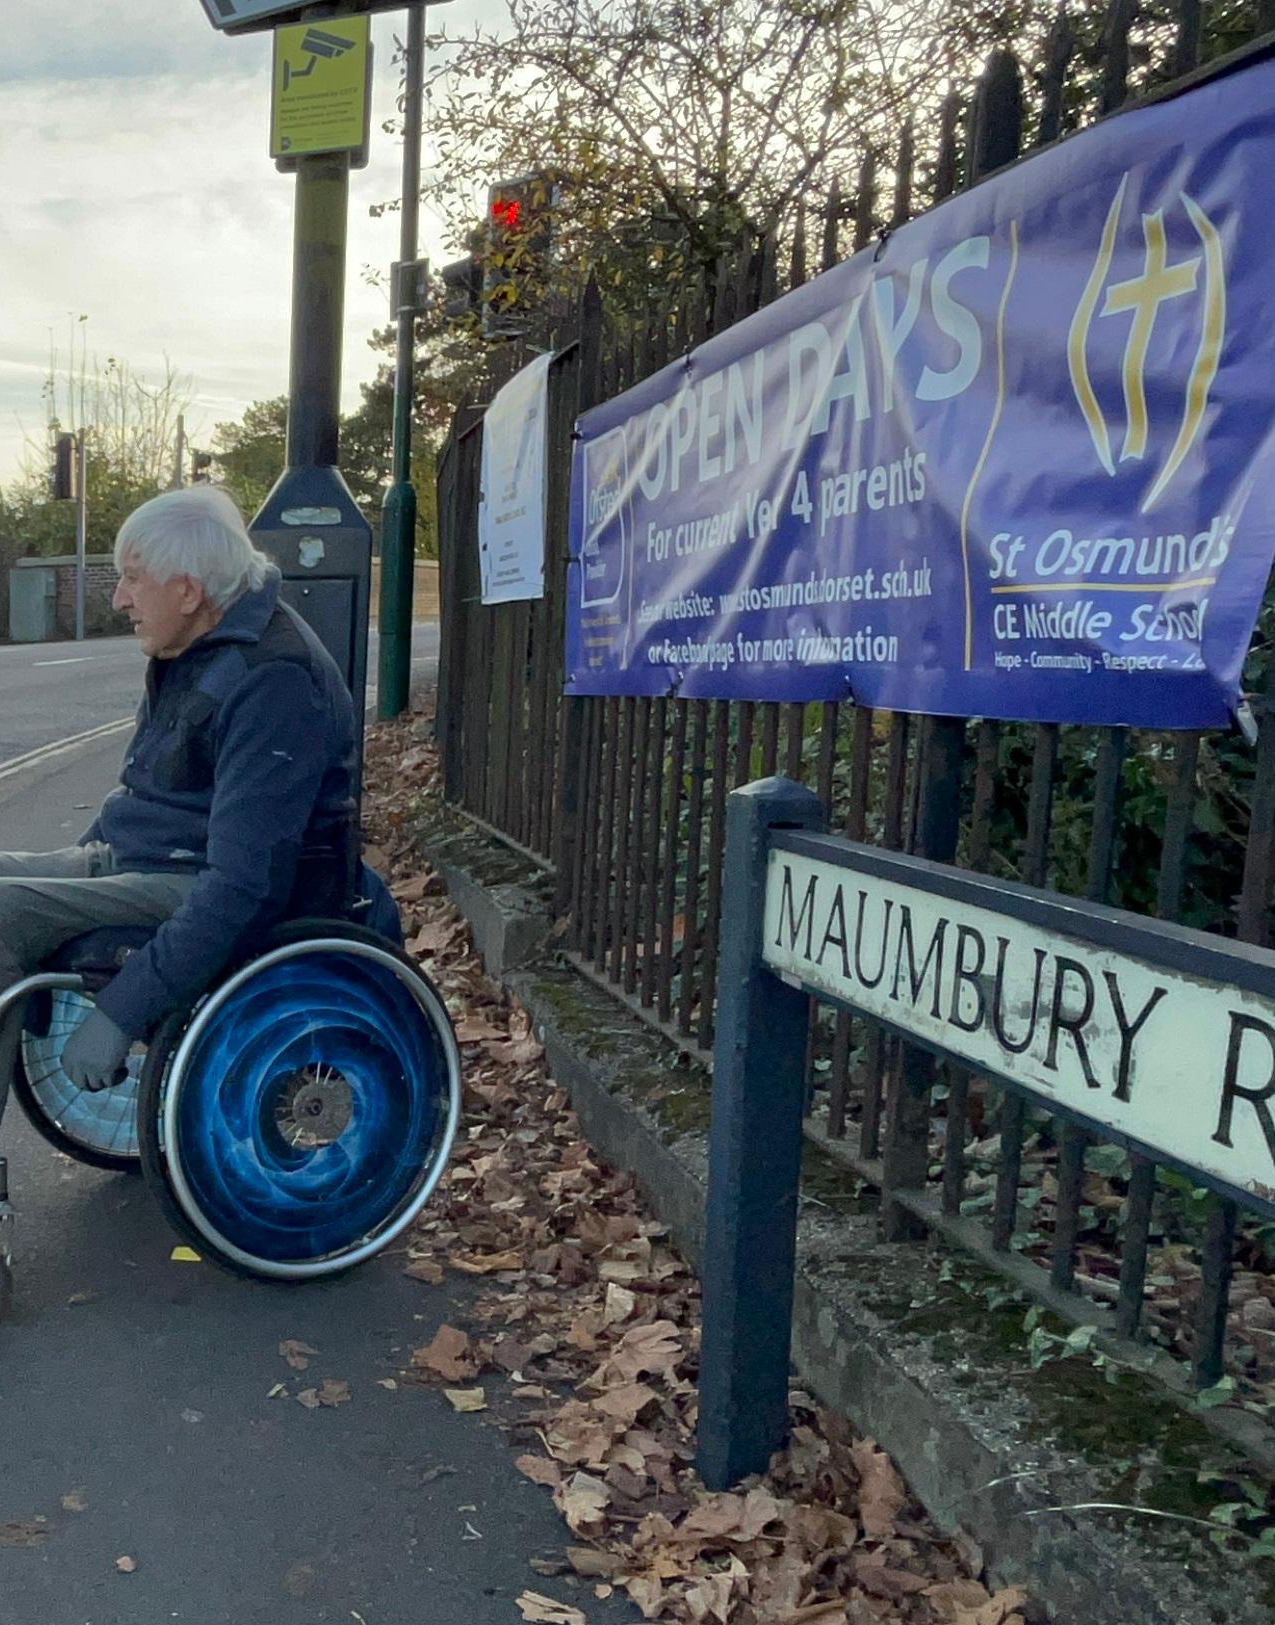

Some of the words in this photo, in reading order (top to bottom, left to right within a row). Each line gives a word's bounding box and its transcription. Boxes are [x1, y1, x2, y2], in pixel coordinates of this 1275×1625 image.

[638, 349, 765, 501] OPEN
[782, 236, 990, 452] DAYS
[647, 521, 672, 562] For
[676, 510, 737, 555] current
[791, 470, 813, 524] 4
[820, 445, 927, 537] parents
[989, 532, 1026, 579] St
[994, 604, 1020, 640] CE
[1024, 600, 1112, 640] Middle
[736, 632, 760, 663] for
[762, 637, 793, 661] more
[994, 651, 1022, 672] Hope
[1102, 652, 1168, 674] Respect
[775, 865, 1168, 1103] MAUMBURY
